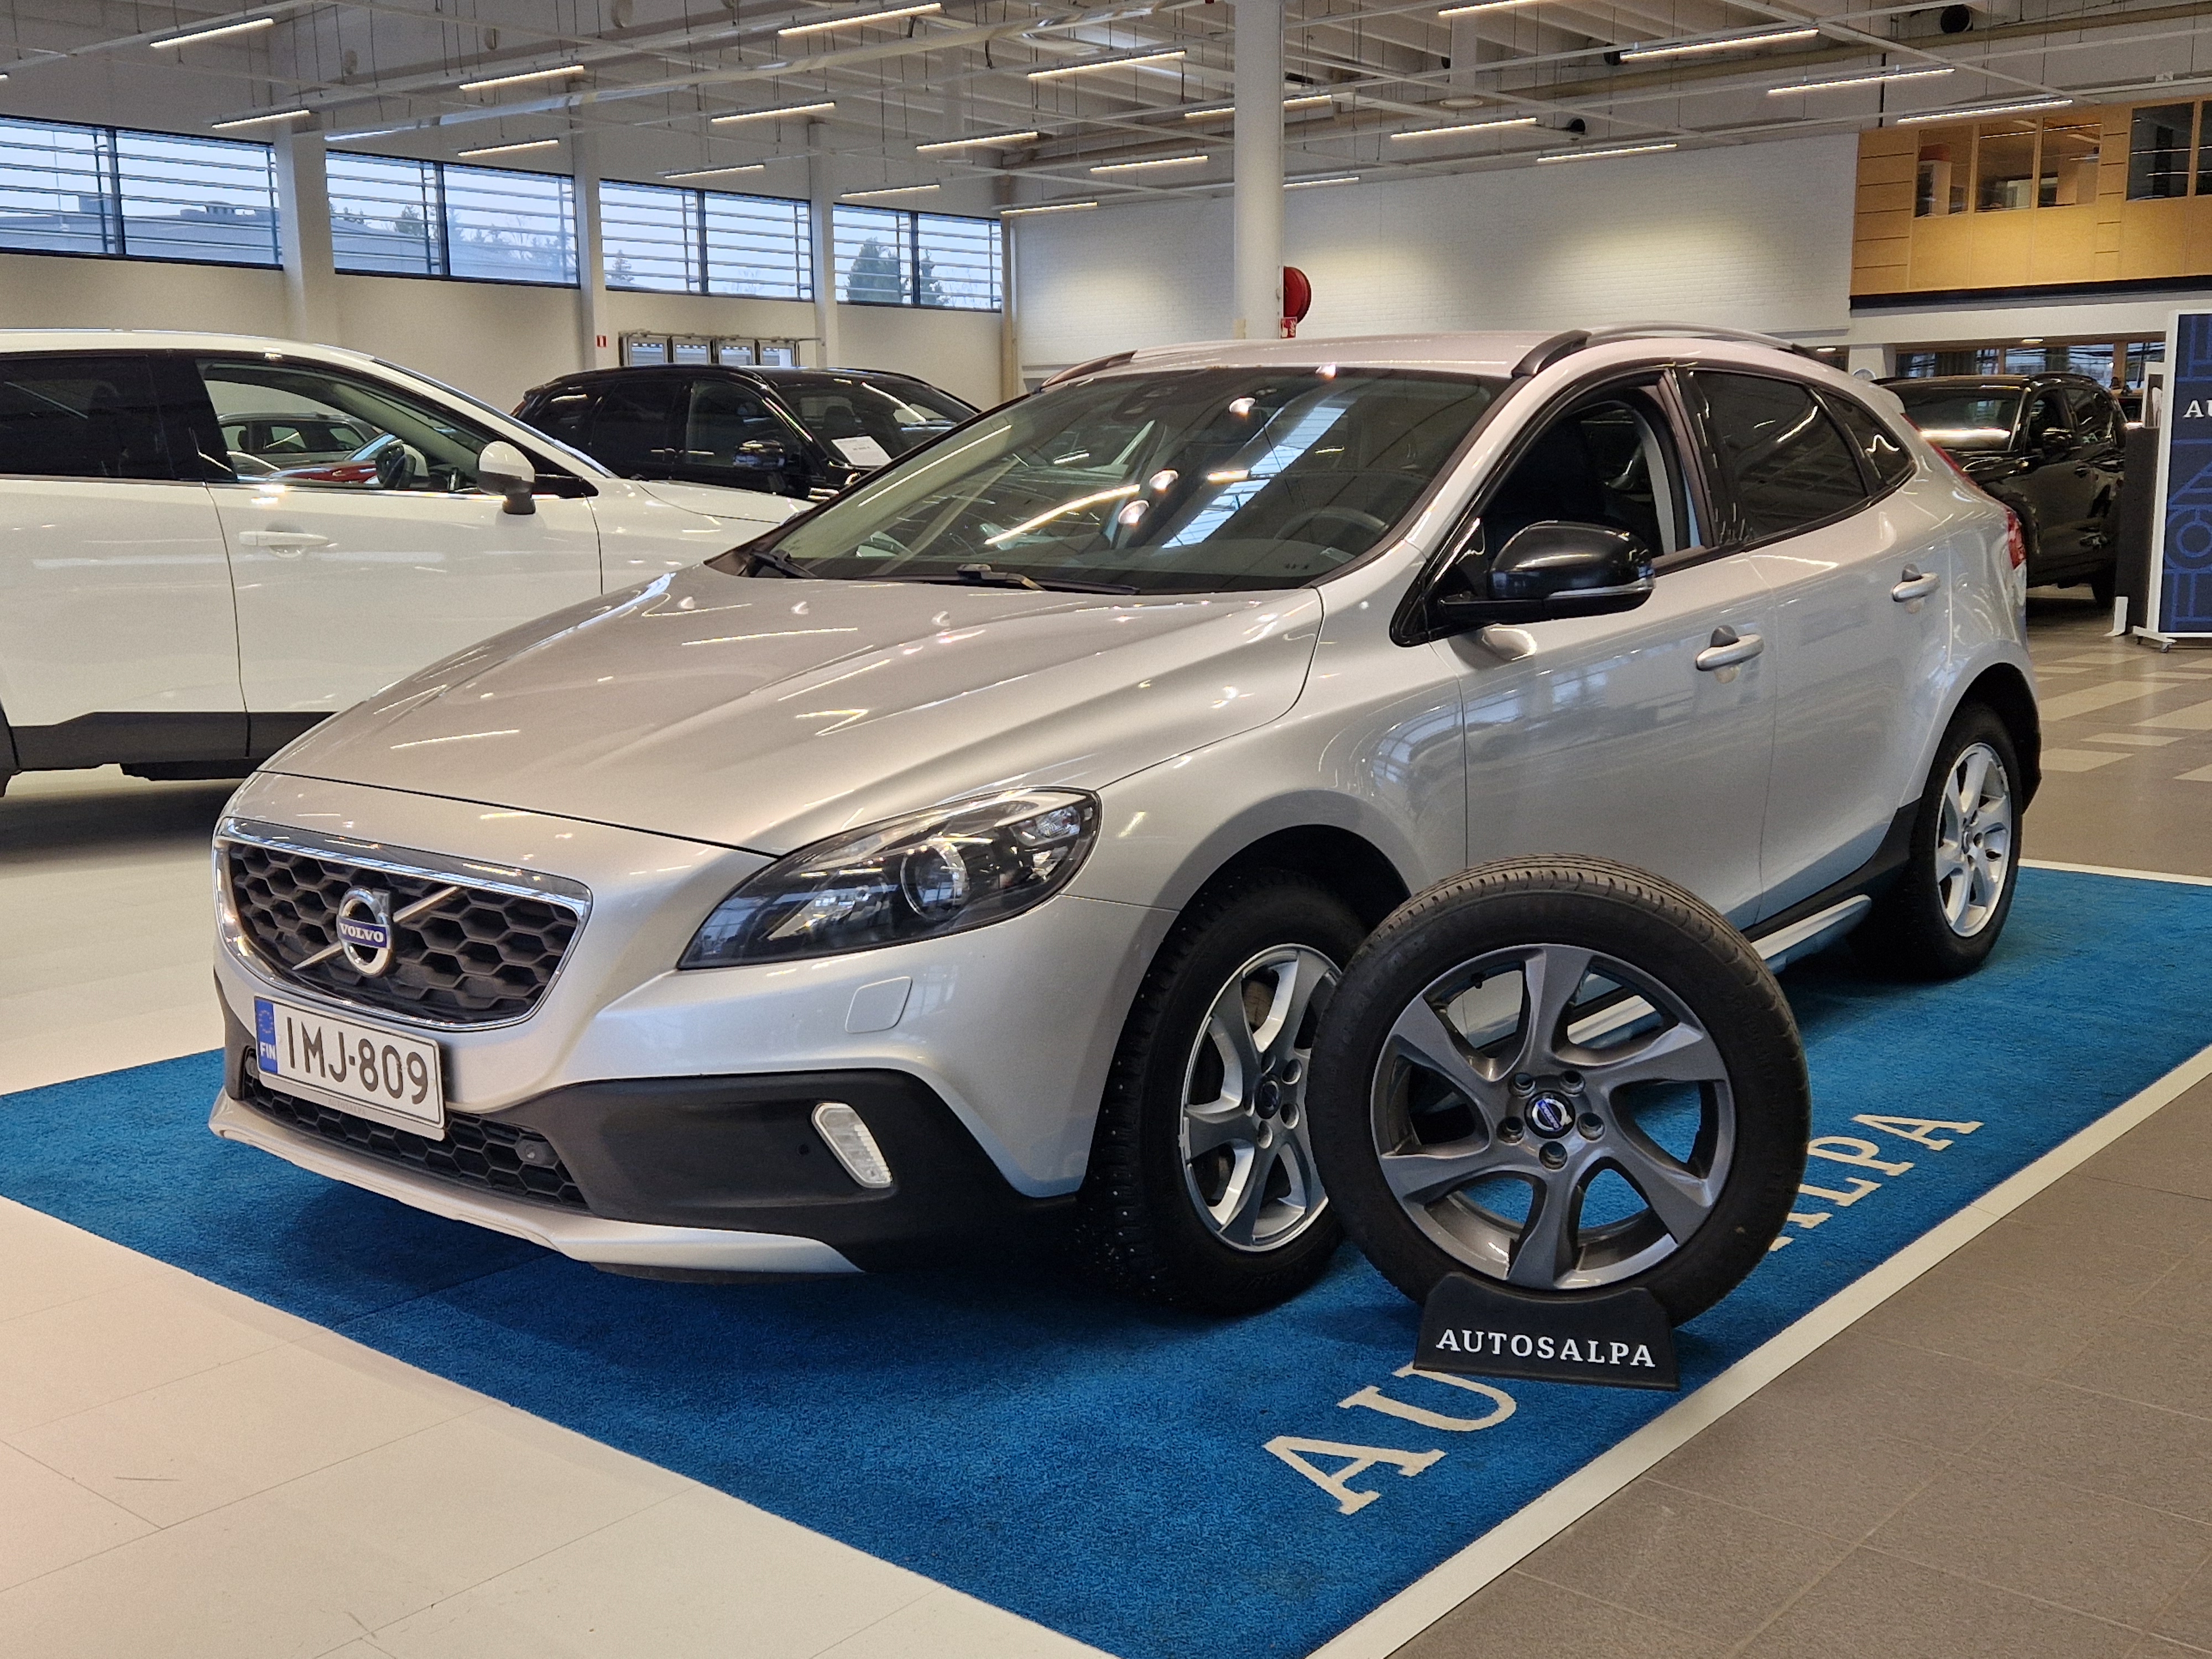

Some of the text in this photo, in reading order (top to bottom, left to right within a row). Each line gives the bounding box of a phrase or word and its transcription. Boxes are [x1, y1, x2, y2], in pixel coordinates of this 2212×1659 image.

[340, 922, 384, 942] VOLVO
[260, 1041, 276, 1061] FIN
[286, 1016, 428, 1105] IMJ-809
[1436, 1329, 1656, 1368] AUTOSALPA
